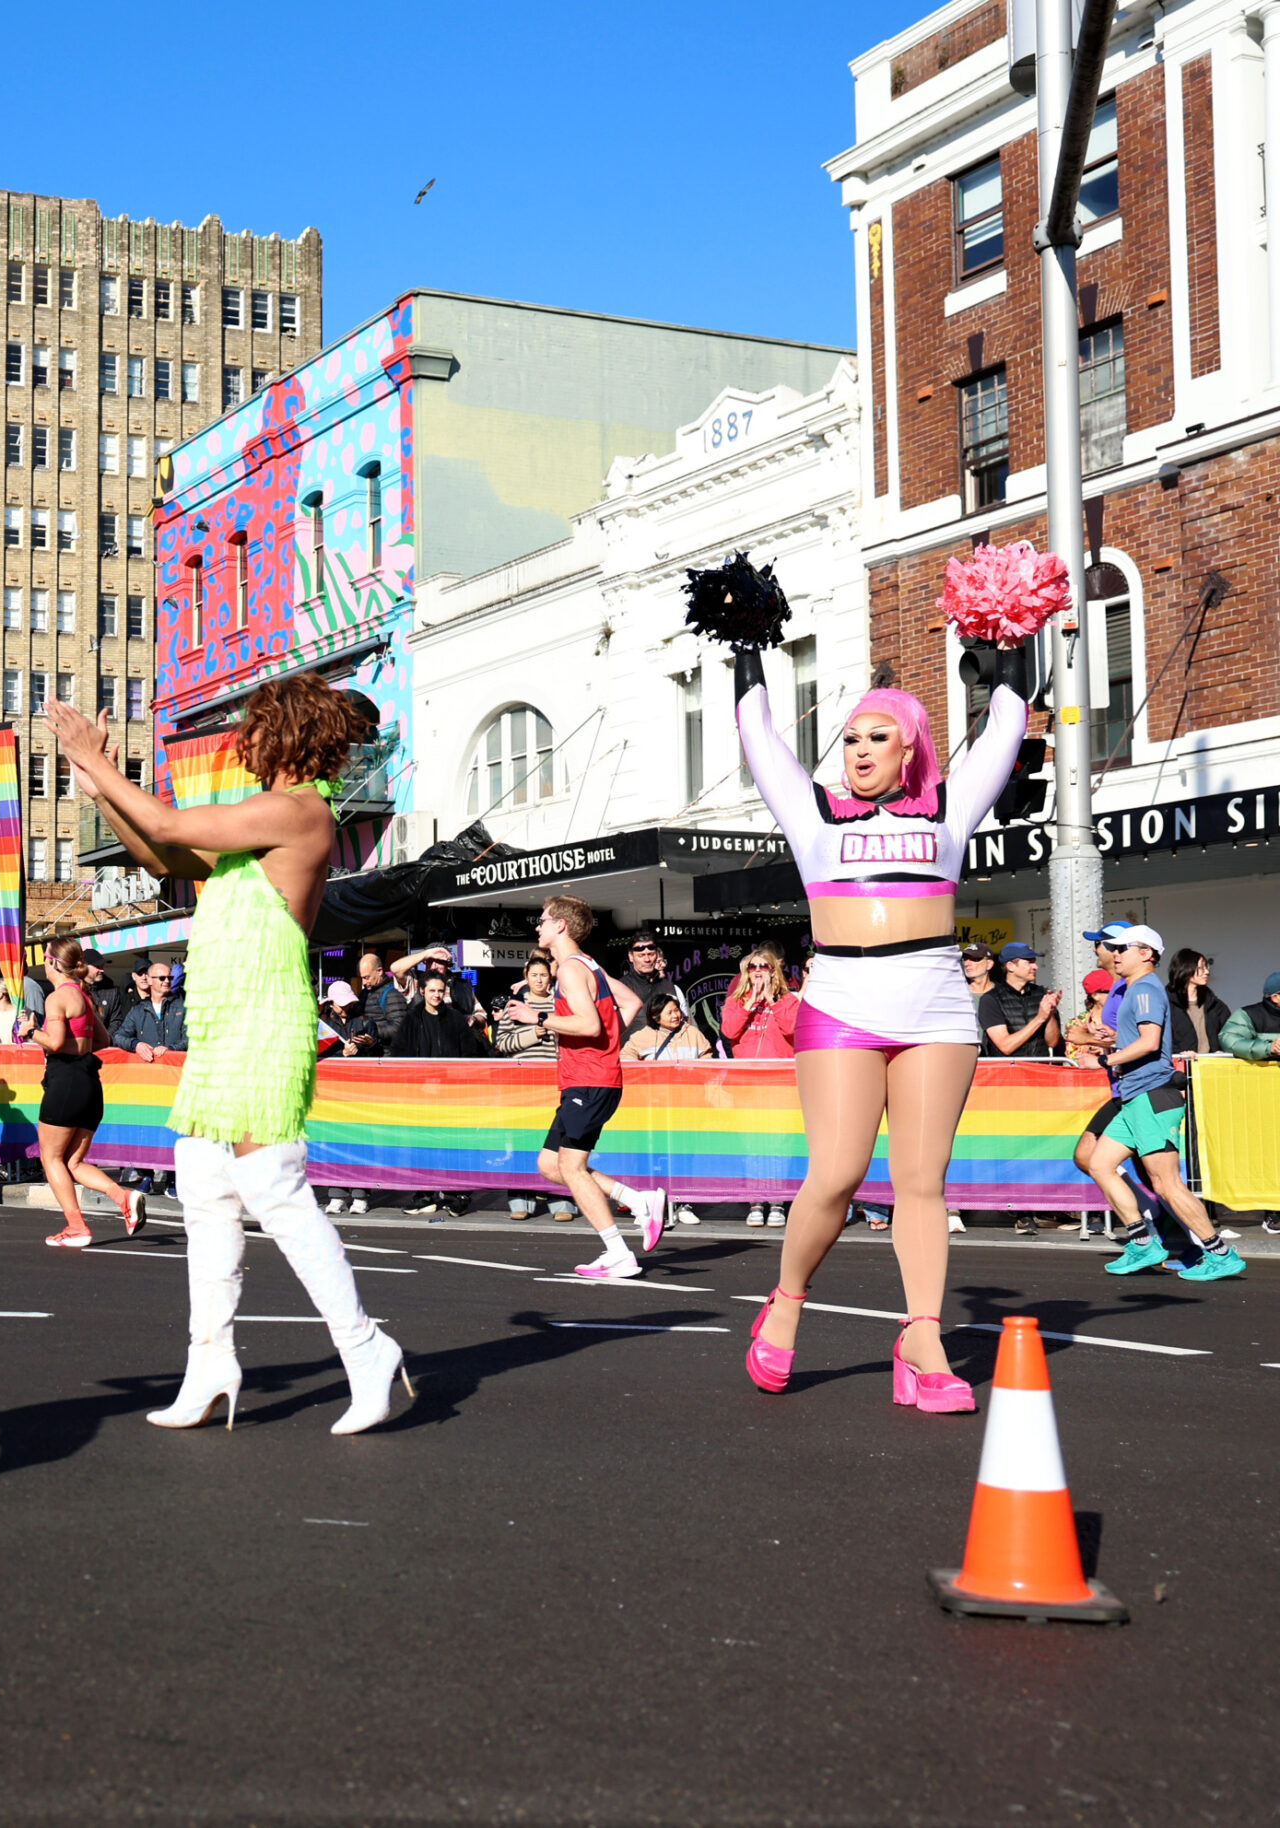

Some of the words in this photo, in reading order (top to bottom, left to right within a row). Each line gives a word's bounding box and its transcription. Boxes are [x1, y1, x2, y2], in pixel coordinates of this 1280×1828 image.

[703, 410, 753, 453] 1887
[691, 835, 786, 853] JUDGEMENT
[969, 834, 1005, 869] IN
[1027, 805, 1197, 862] SSION
[1227, 791, 1280, 834] SI
[841, 832, 937, 863] DANNI
[455, 873, 470, 886] THE
[470, 848, 586, 886] COURTHOUSE
[587, 847, 616, 864] HOTEL
[663, 926, 724, 936] JUDGEMENT
[729, 928, 753, 936] FREE
[482, 949, 529, 960] KINSEL
[667, 950, 701, 982] YLOR
[690, 976, 729, 1000] DARLING
